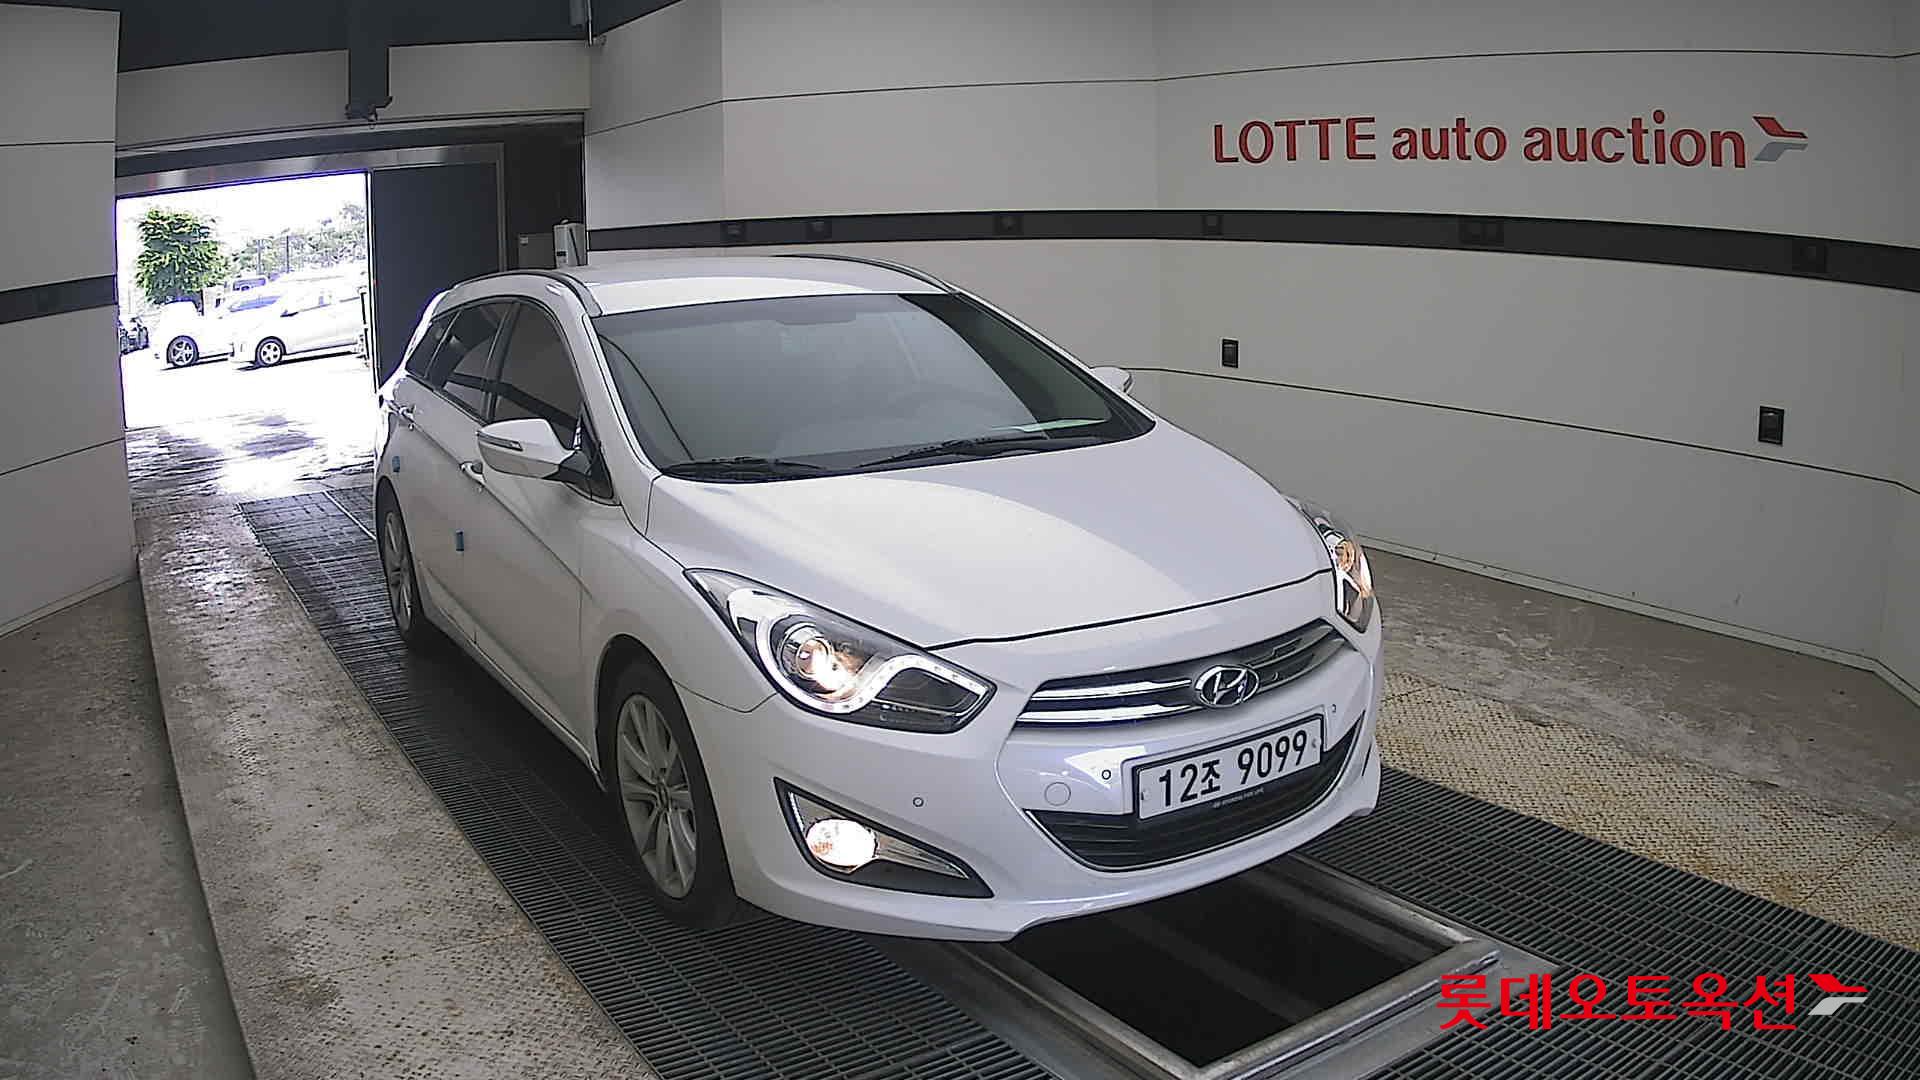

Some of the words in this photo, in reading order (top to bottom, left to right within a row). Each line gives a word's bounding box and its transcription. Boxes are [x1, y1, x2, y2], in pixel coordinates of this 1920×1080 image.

[1213, 116, 1376, 164] LOTTE
[1391, 117, 1507, 162] auto
[1522, 110, 1746, 168] auction
[1159, 759, 1221, 807] 12조
[1237, 730, 1308, 785] 9099
